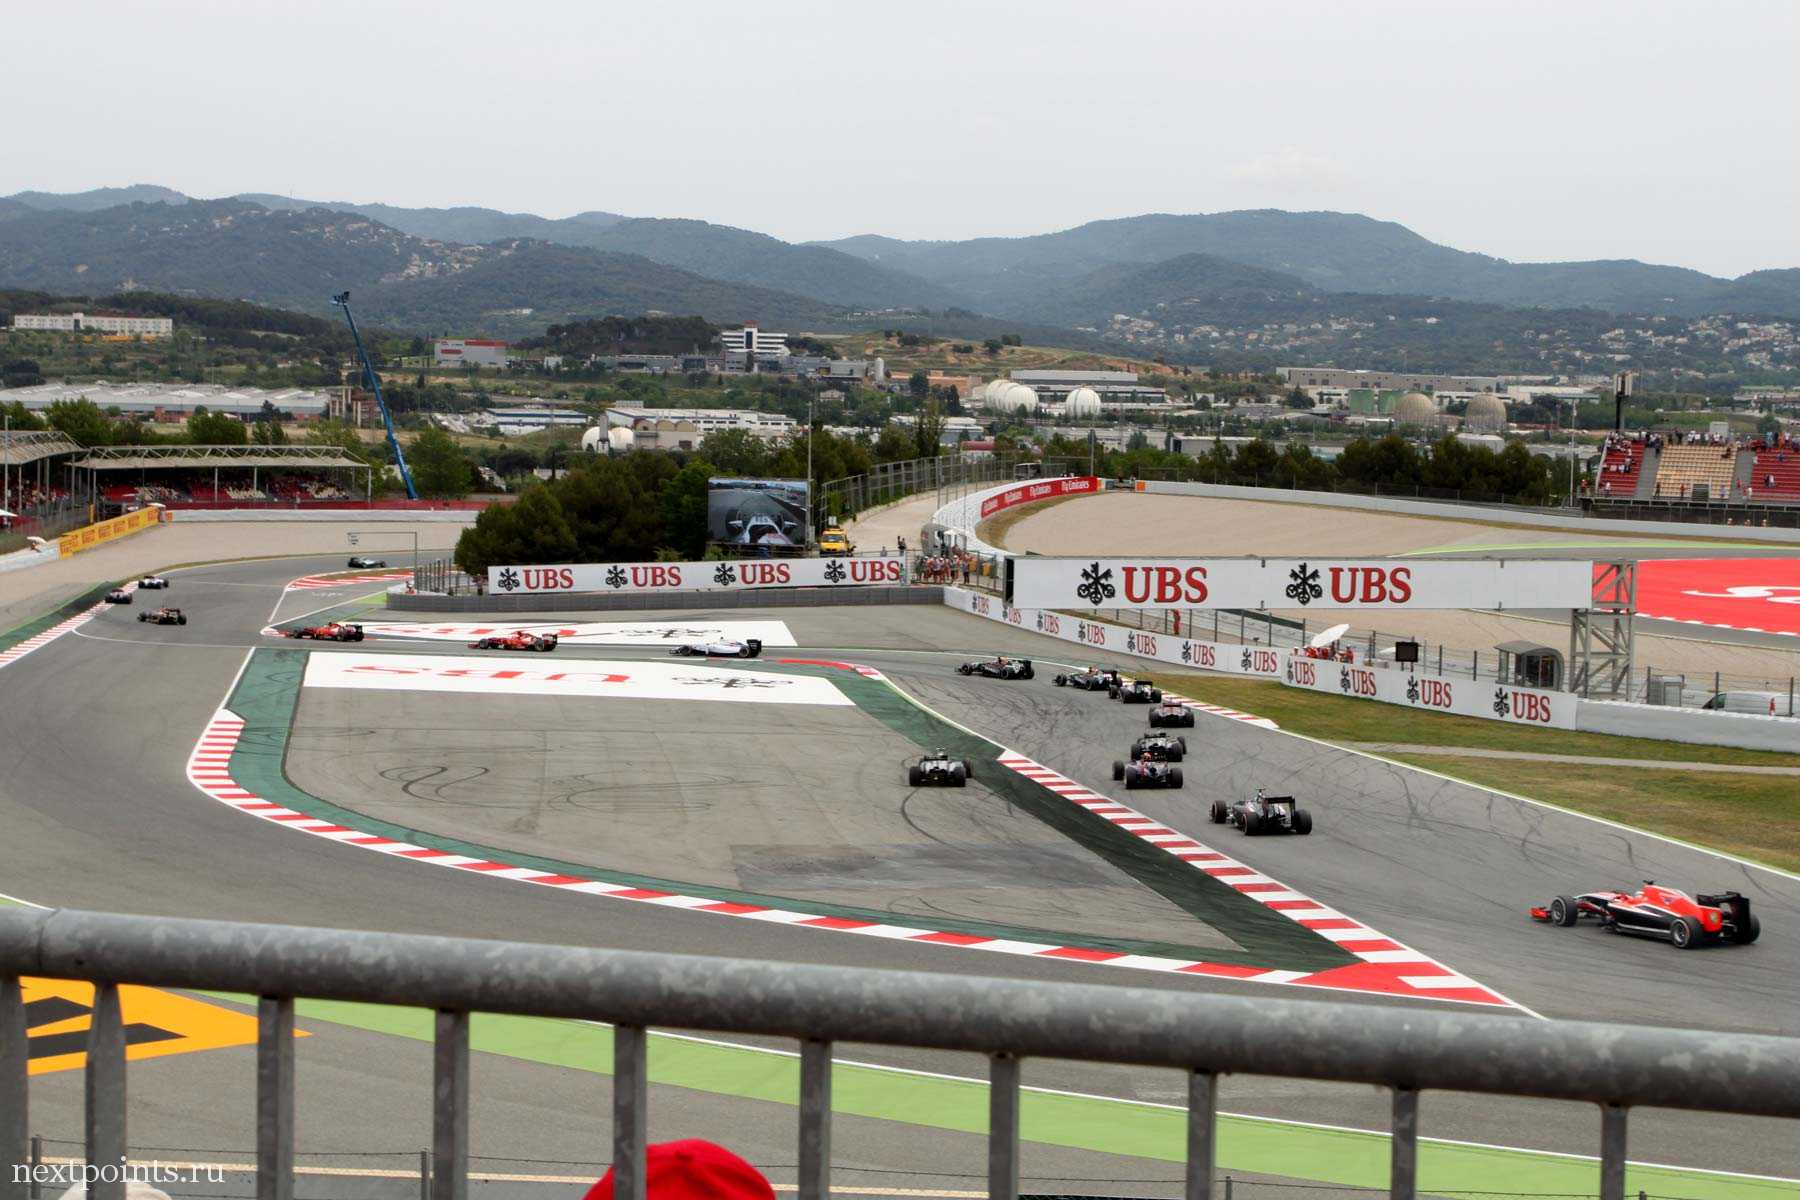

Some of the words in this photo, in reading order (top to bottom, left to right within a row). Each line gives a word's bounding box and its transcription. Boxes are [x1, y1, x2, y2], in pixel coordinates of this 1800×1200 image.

[523, 568, 576, 590] UBS
[631, 565, 682, 588] UBS
[739, 562, 791, 585] UBS
[849, 560, 900, 582] UBS
[1122, 566, 1208, 603] UBS
[1329, 566, 1412, 603] UBS
[1044, 614, 1060, 634] UBS
[1087, 624, 1105, 645] UBS
[1136, 634, 1157, 656] UBS
[1193, 644, 1215, 666] UBS
[1254, 650, 1277, 673] UBS
[1295, 661, 1315, 686] UBS
[1351, 669, 1376, 696] UBS
[1421, 679, 1452, 708] UBS
[1511, 691, 1551, 723] UBS
